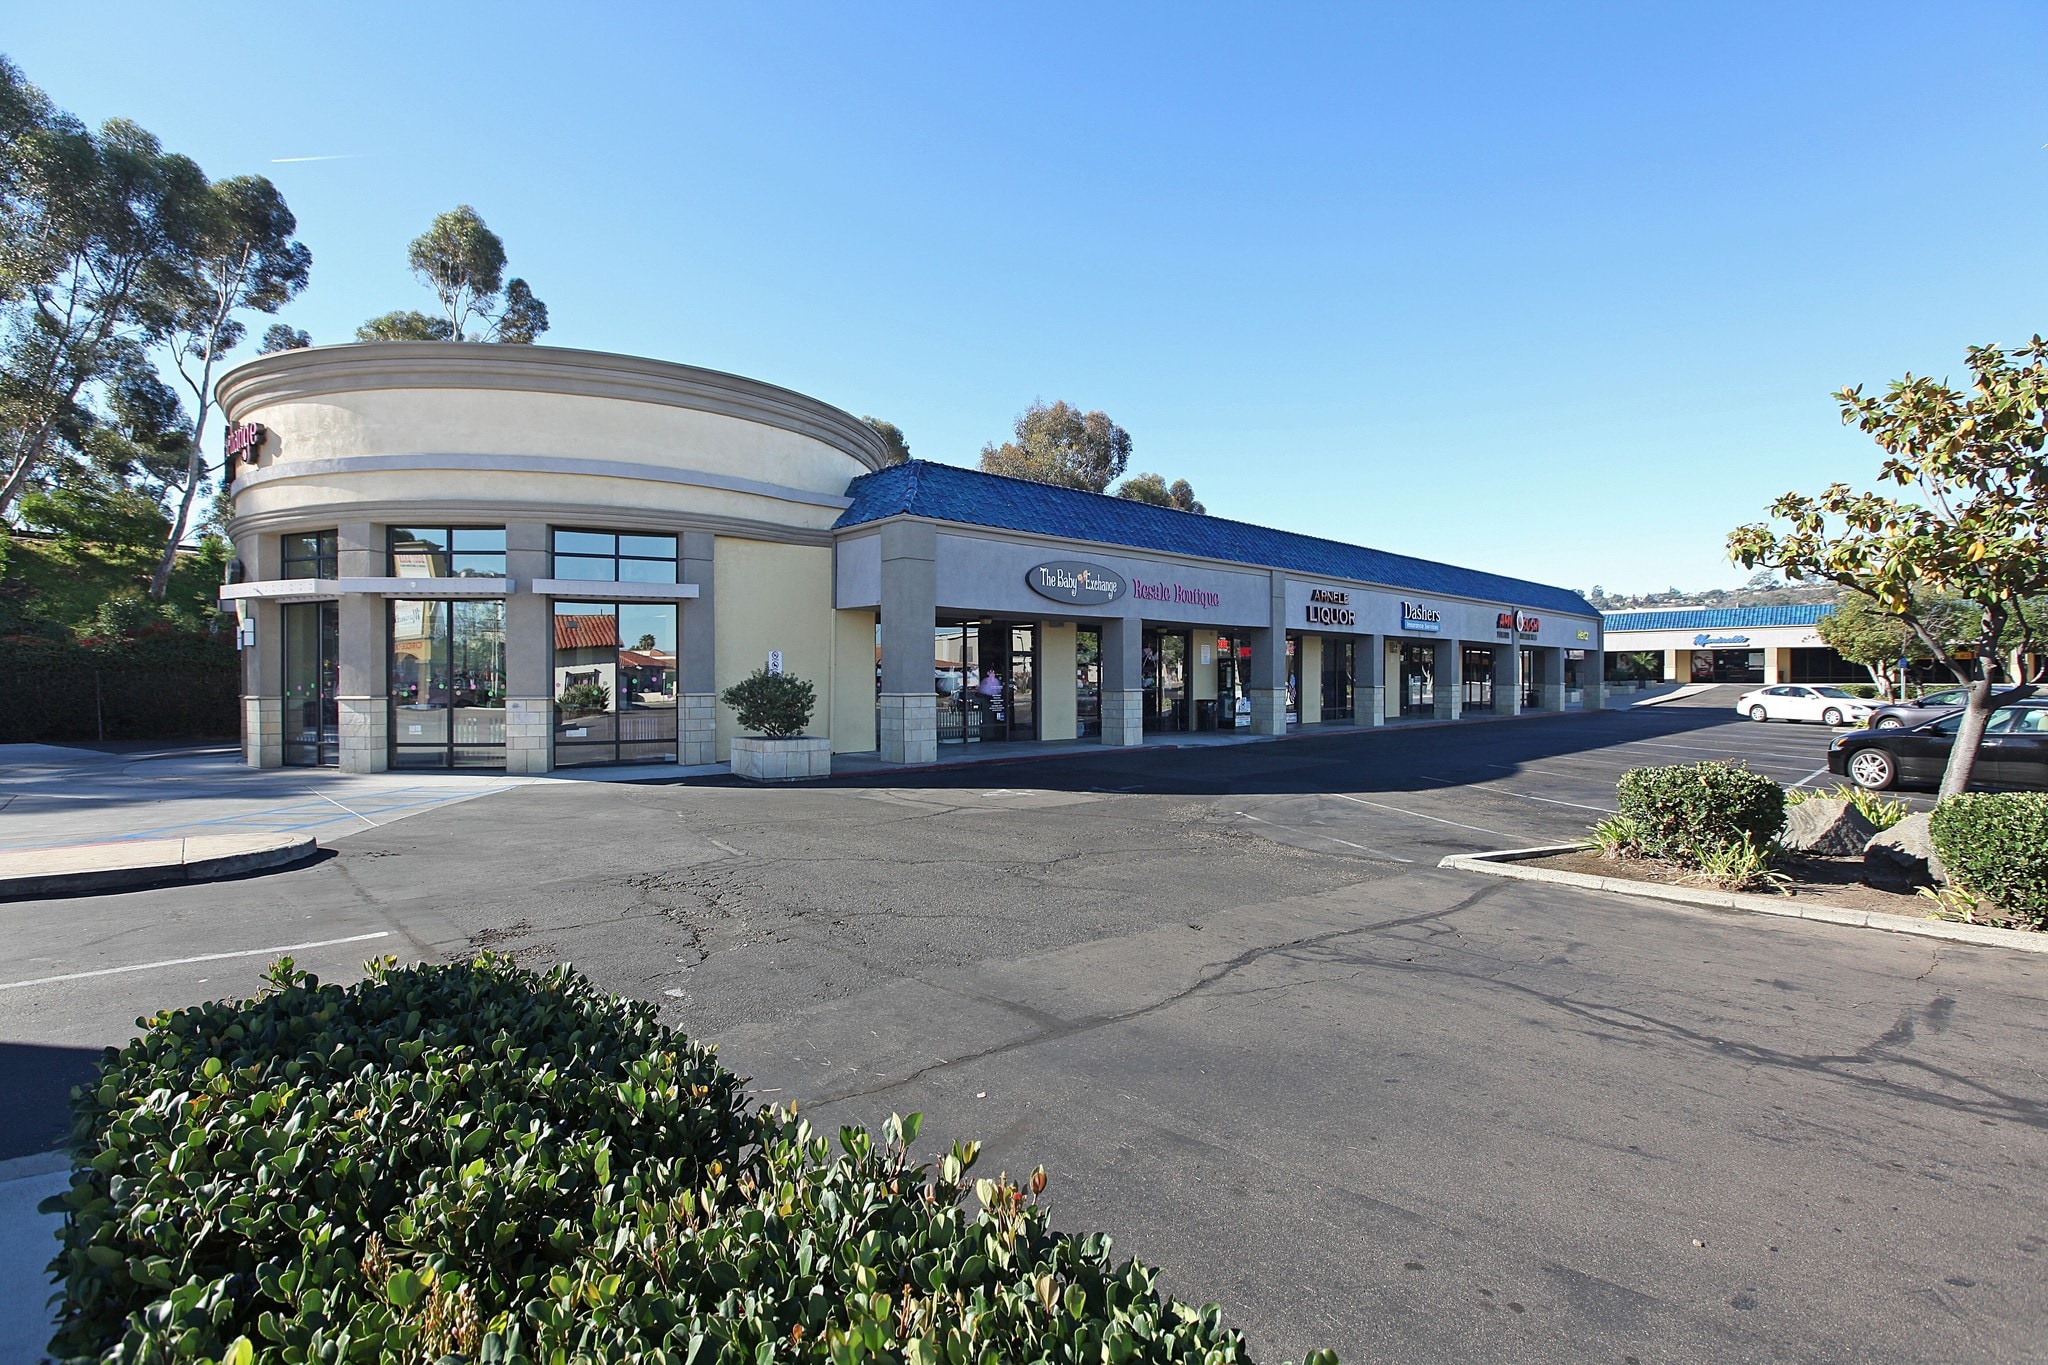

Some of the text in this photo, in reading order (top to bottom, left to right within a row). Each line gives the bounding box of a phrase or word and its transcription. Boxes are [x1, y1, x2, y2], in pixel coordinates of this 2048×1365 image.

[1040, 567, 1118, 600] The Baby Exchange
[1132, 578, 1219, 609] Resale Boutique
[1313, 589, 1349, 605] ARNELE
[1308, 605, 1356, 625] LIQUOR
[1403, 601, 1441, 622] Dashers
